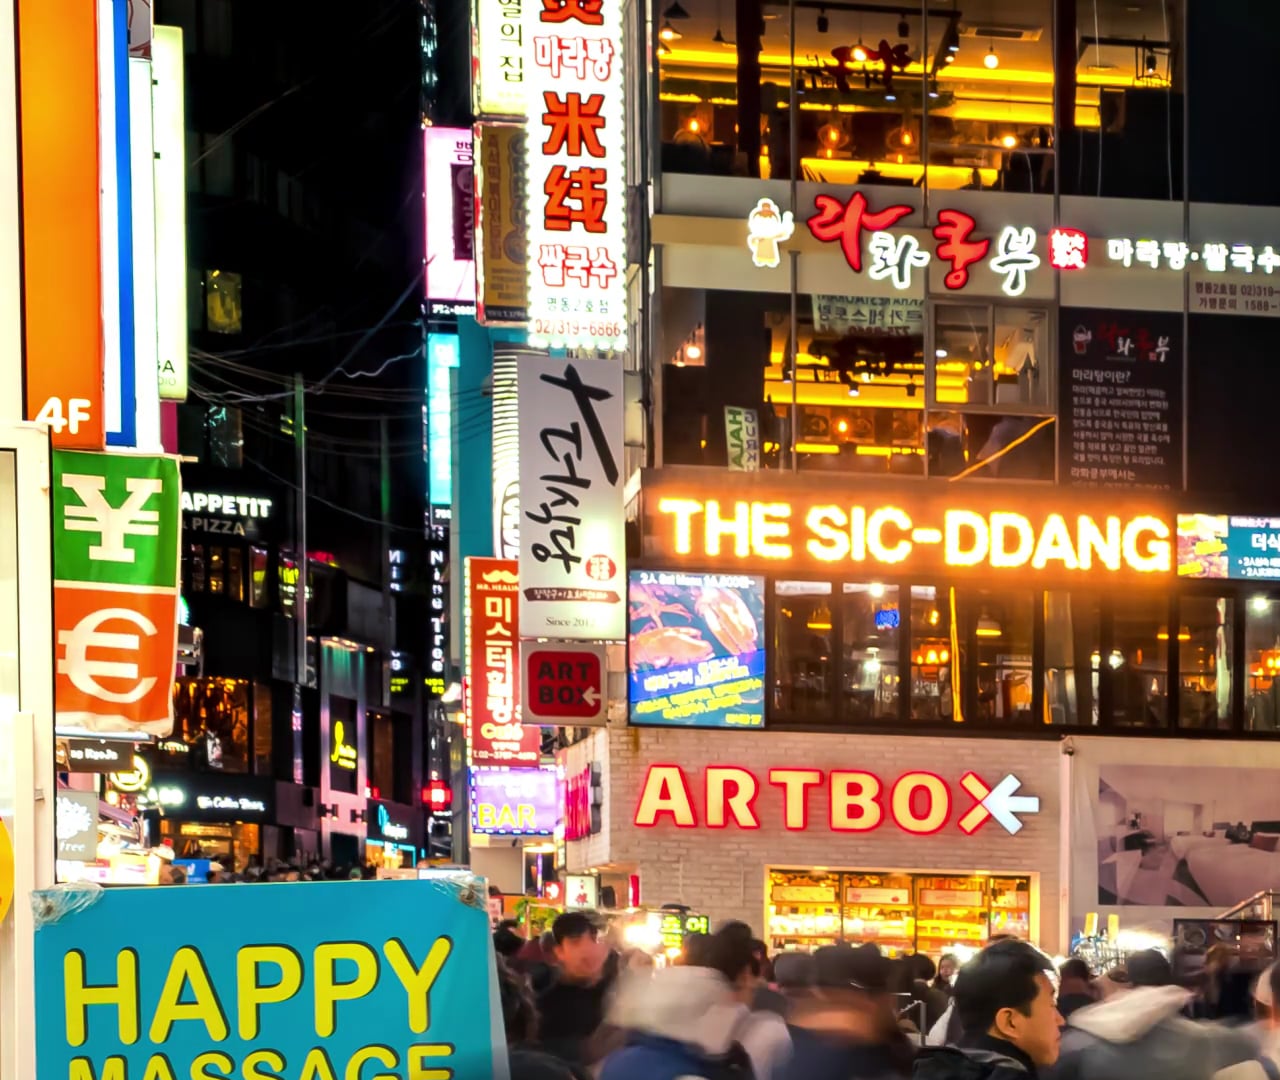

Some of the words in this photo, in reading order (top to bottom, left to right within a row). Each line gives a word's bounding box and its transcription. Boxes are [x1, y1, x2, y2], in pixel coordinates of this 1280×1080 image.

[534, 35, 615, 82] 마라탕
[541, 90, 608, 233] 米线
[538, 244, 617, 289] 쌀국수
[35, 397, 91, 434] 4F
[181, 492, 272, 518] APPETIT
[192, 519, 246, 536] PIZZA
[658, 497, 793, 560] THE
[804, 504, 1172, 572] SIC-DDANG
[572, 618, 595, 628] 201
[537, 661, 593, 682] ART
[478, 804, 537, 828] BAR
[634, 764, 1000, 836] ARTBOX
[63, 934, 455, 1047] HAPPY
